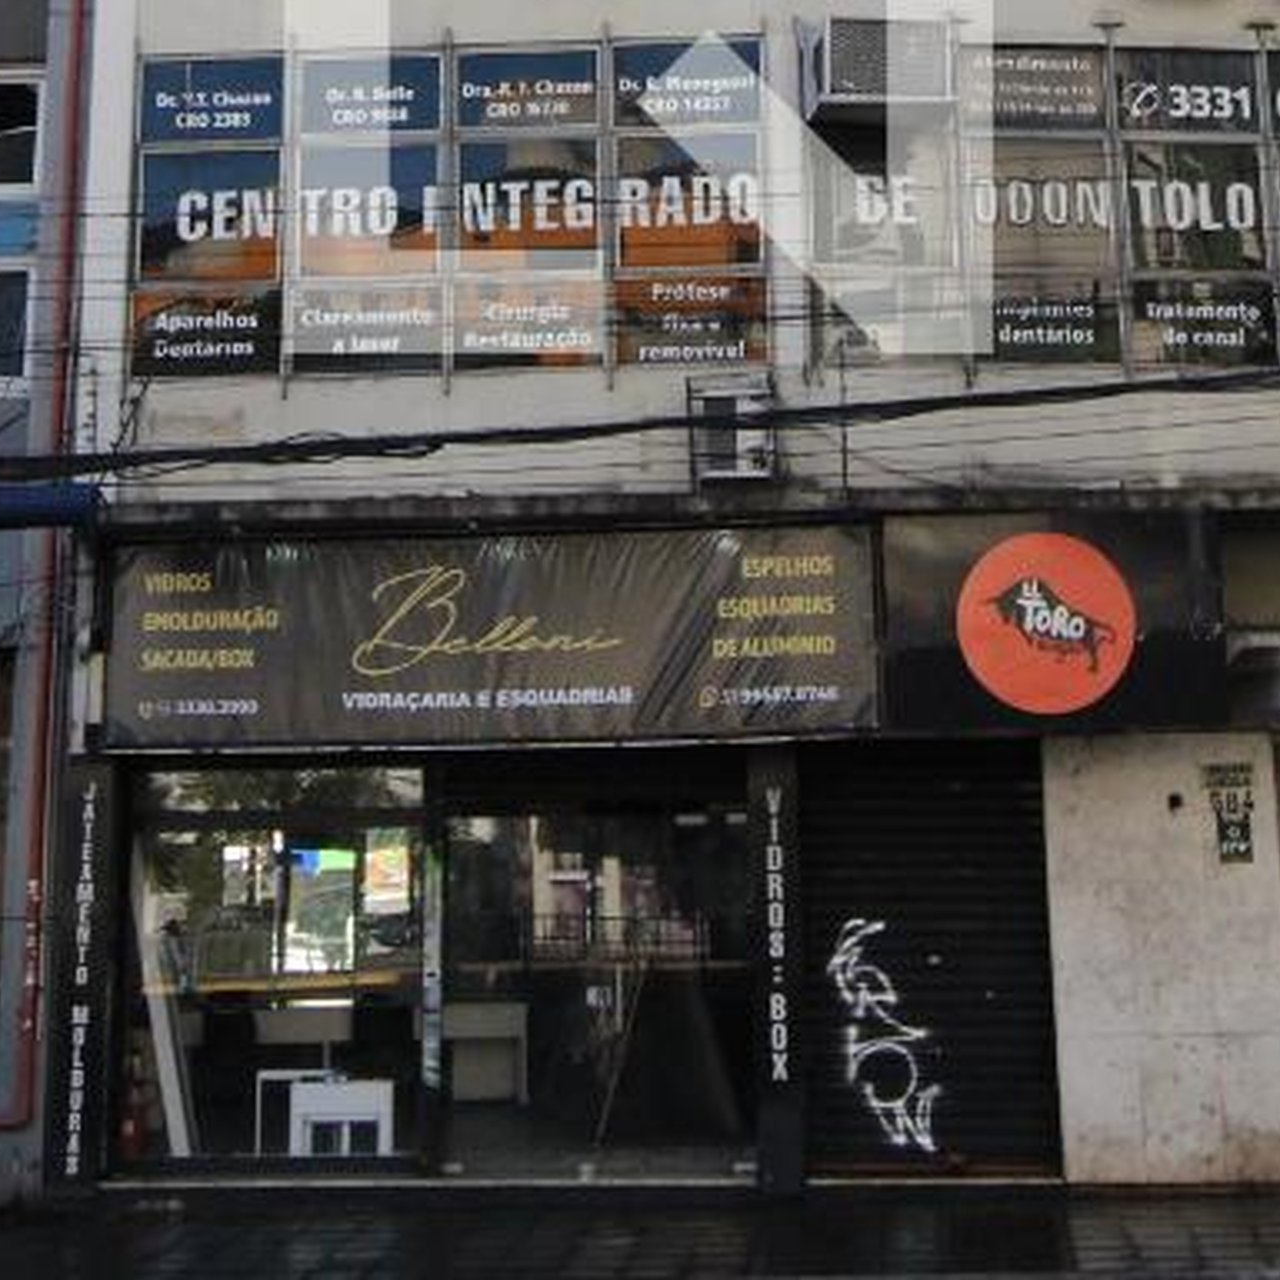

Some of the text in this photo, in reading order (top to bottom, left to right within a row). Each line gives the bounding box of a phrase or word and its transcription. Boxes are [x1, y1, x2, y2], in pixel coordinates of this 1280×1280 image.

[1169, 85, 1251, 118] 3331
[176, 186, 398, 242] CENTRO
[423, 174, 761, 234] INTEGRADO
[154, 311, 259, 332] Aparelhos
[1144, 301, 1262, 323] Tratamento
[1192, 325, 1247, 346] canal
[741, 554, 835, 578] ESPELHOS
[143, 571, 212, 596] VIDROS
[1021, 578, 1042, 598] EL
[342, 691, 471, 711] VIDRAÇARIA
[475, 690, 491, 708] E
[765, 786, 789, 1082] VIDROS BOX
